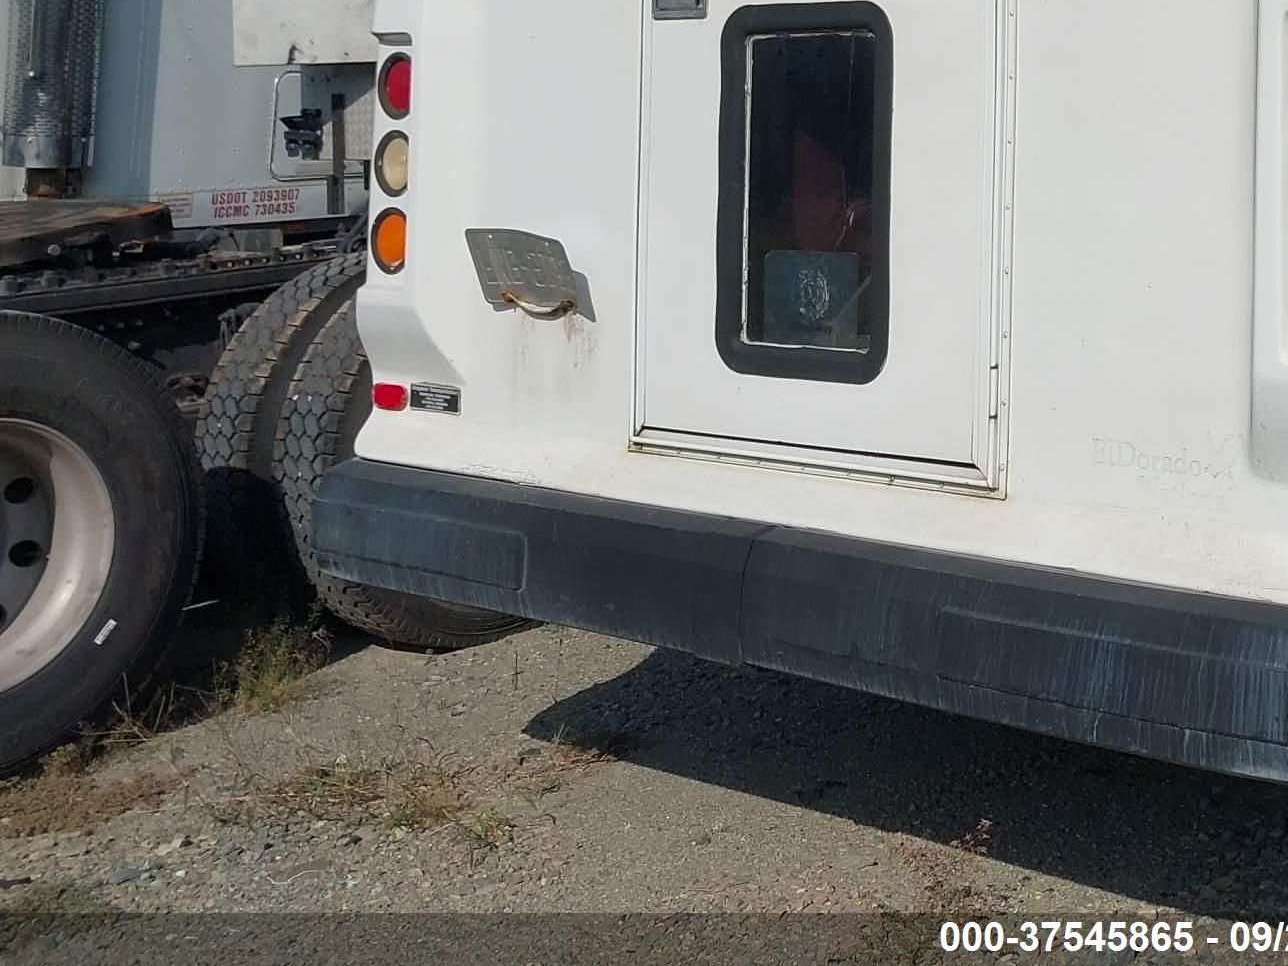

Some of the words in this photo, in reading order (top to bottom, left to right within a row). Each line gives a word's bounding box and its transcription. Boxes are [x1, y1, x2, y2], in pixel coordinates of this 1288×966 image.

[211, 192, 248, 205] USDOT
[252, 189, 300, 203] 2093907
[213, 205, 250, 219] ICCMC
[255, 202, 295, 216] 730435
